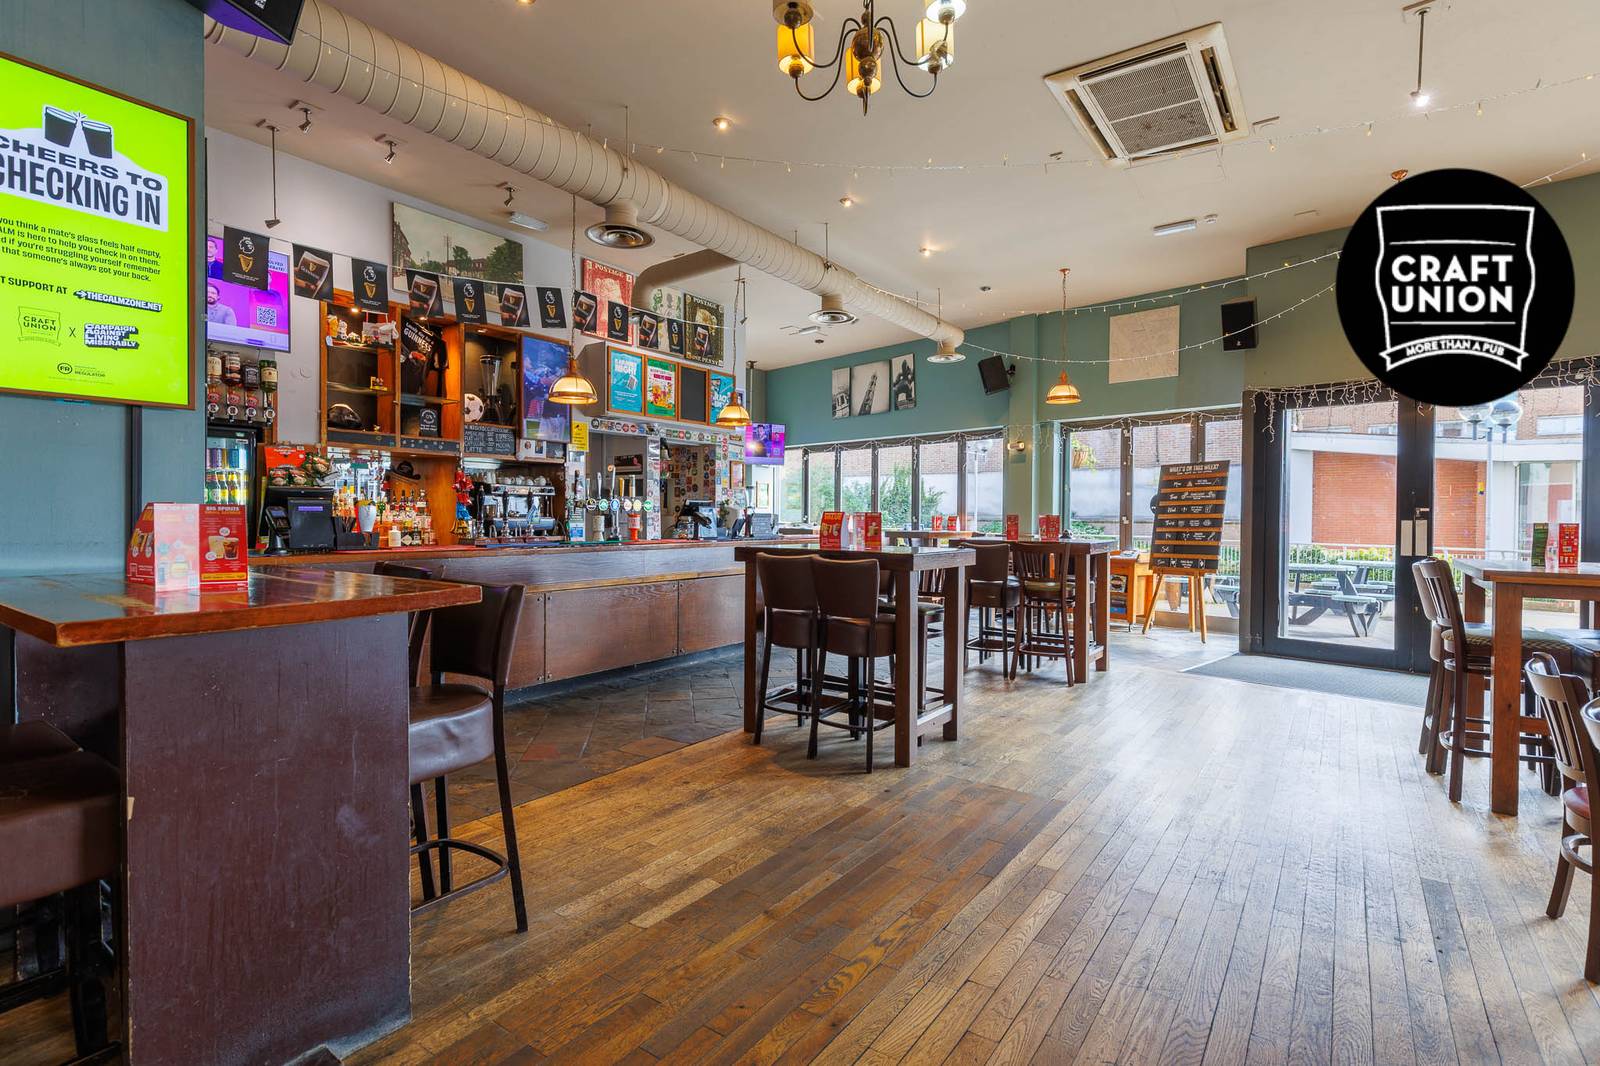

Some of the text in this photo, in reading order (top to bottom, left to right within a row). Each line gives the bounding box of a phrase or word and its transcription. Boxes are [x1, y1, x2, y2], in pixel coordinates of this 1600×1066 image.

[0, 152, 161, 226] HECKING IN
[126, 171, 163, 192] TO
[16, 219, 39, 232] think
[48, 228, 76, 240] mate's
[77, 234, 98, 244] glass
[100, 238, 119, 249] feels
[120, 243, 135, 252] half
[17, 230, 25, 238] is
[27, 231, 46, 242] here
[48, 236, 57, 244] to
[58, 239, 77, 249] help
[78, 244, 93, 252] you
[94, 247, 118, 257] check
[128, 254, 138, 262] on
[1, 245, 21, 256] that
[69, 260, 97, 271] always
[98, 265, 112, 274] got
[112, 267, 130, 278] your
[8, 237, 15, 245] if
[45, 246, 89, 261] struggling
[90, 254, 122, 267] yourself
[123, 261, 161, 275] remember
[8, 277, 54, 293] SUPPORT
[56, 285, 68, 294] AT
[86, 291, 162, 312] THECALMZONE.NET
[23, 315, 57, 326] CRAFT
[23, 321, 57, 331] UNION
[84, 323, 136, 333] CAMPAIGN
[84, 329, 127, 337] AGAINST
[84, 332, 120, 341] LIVING
[84, 339, 137, 347] MISERABLY
[403, 327, 433, 352] GUINNESS
